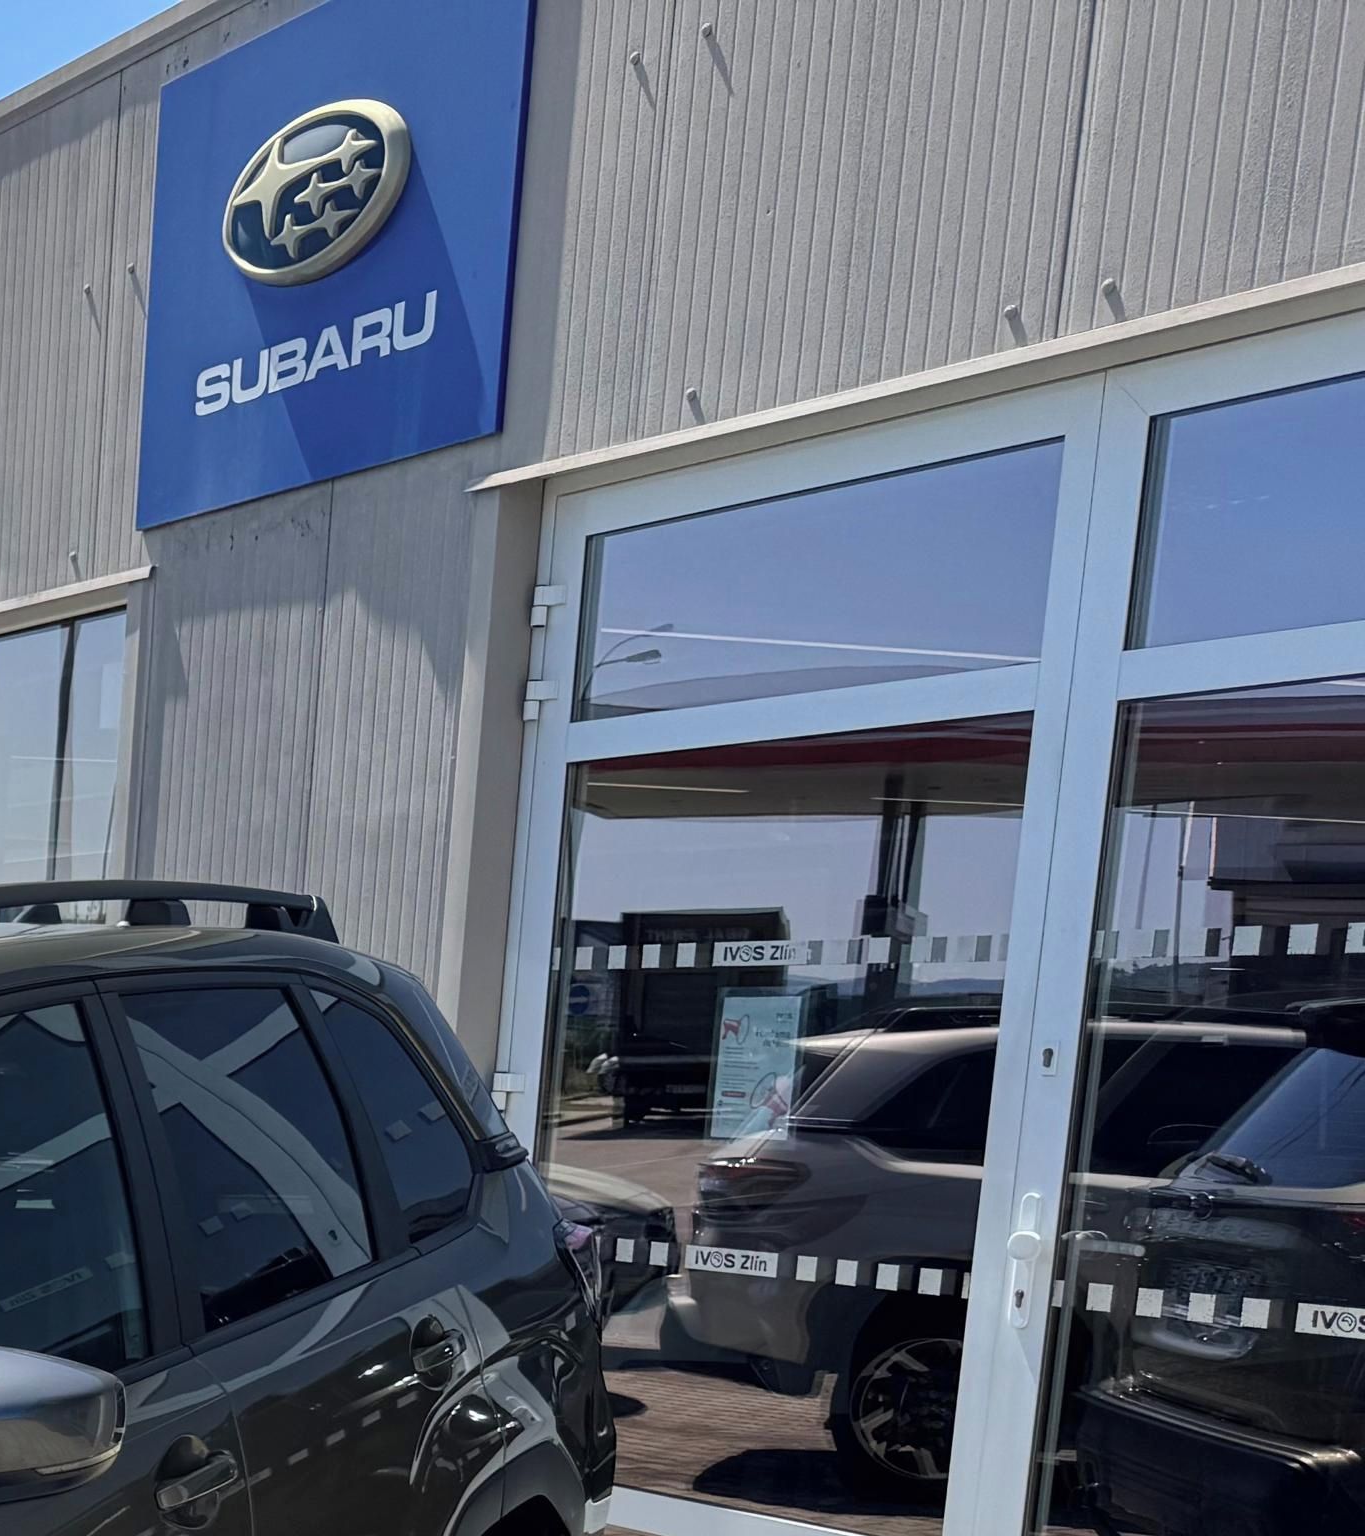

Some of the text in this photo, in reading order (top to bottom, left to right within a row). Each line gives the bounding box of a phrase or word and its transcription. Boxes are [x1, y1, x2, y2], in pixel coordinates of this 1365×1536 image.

[195, 290, 437, 416] SUBARU
[723, 944, 765, 962] IVOS
[695, 1250, 767, 1272] IVOS Zlín
